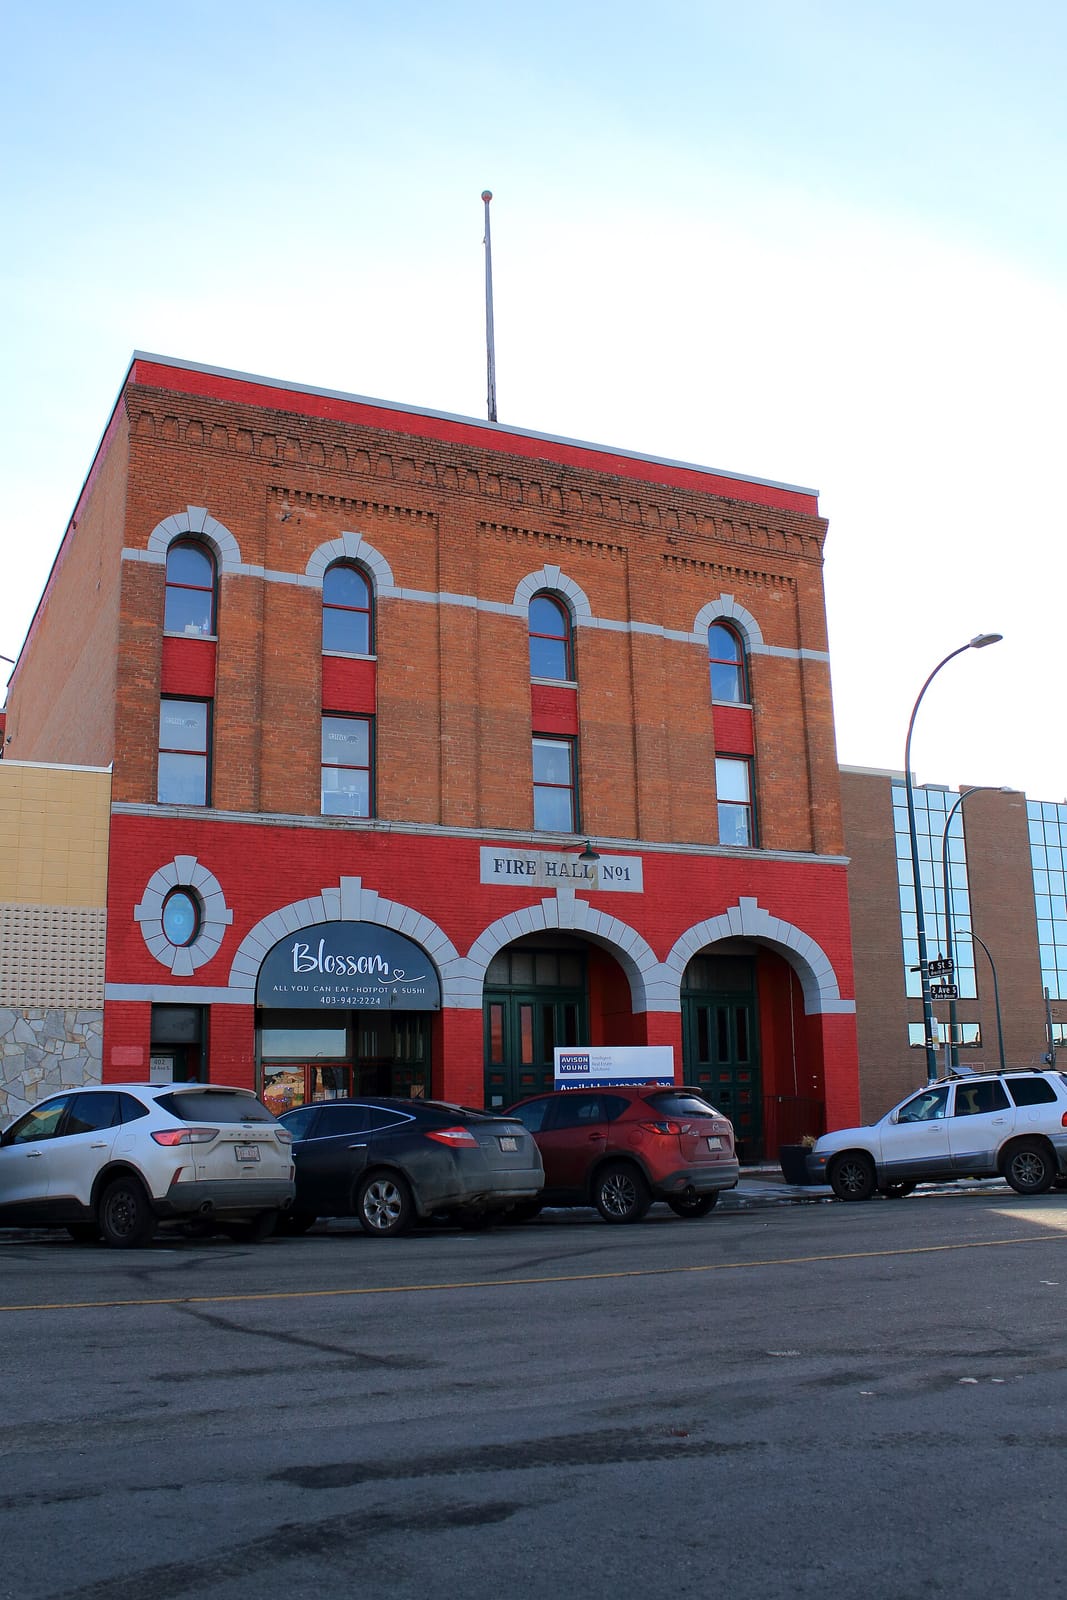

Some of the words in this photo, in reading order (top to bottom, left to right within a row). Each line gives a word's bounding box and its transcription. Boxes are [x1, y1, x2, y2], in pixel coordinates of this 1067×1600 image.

[493, 858, 536, 876] FIRE
[545, 861, 594, 878] HALL
[291, 938, 388, 976] Blossom
[937, 961, 946, 970] St
[320, 996, 381, 1004] 403-942-2224
